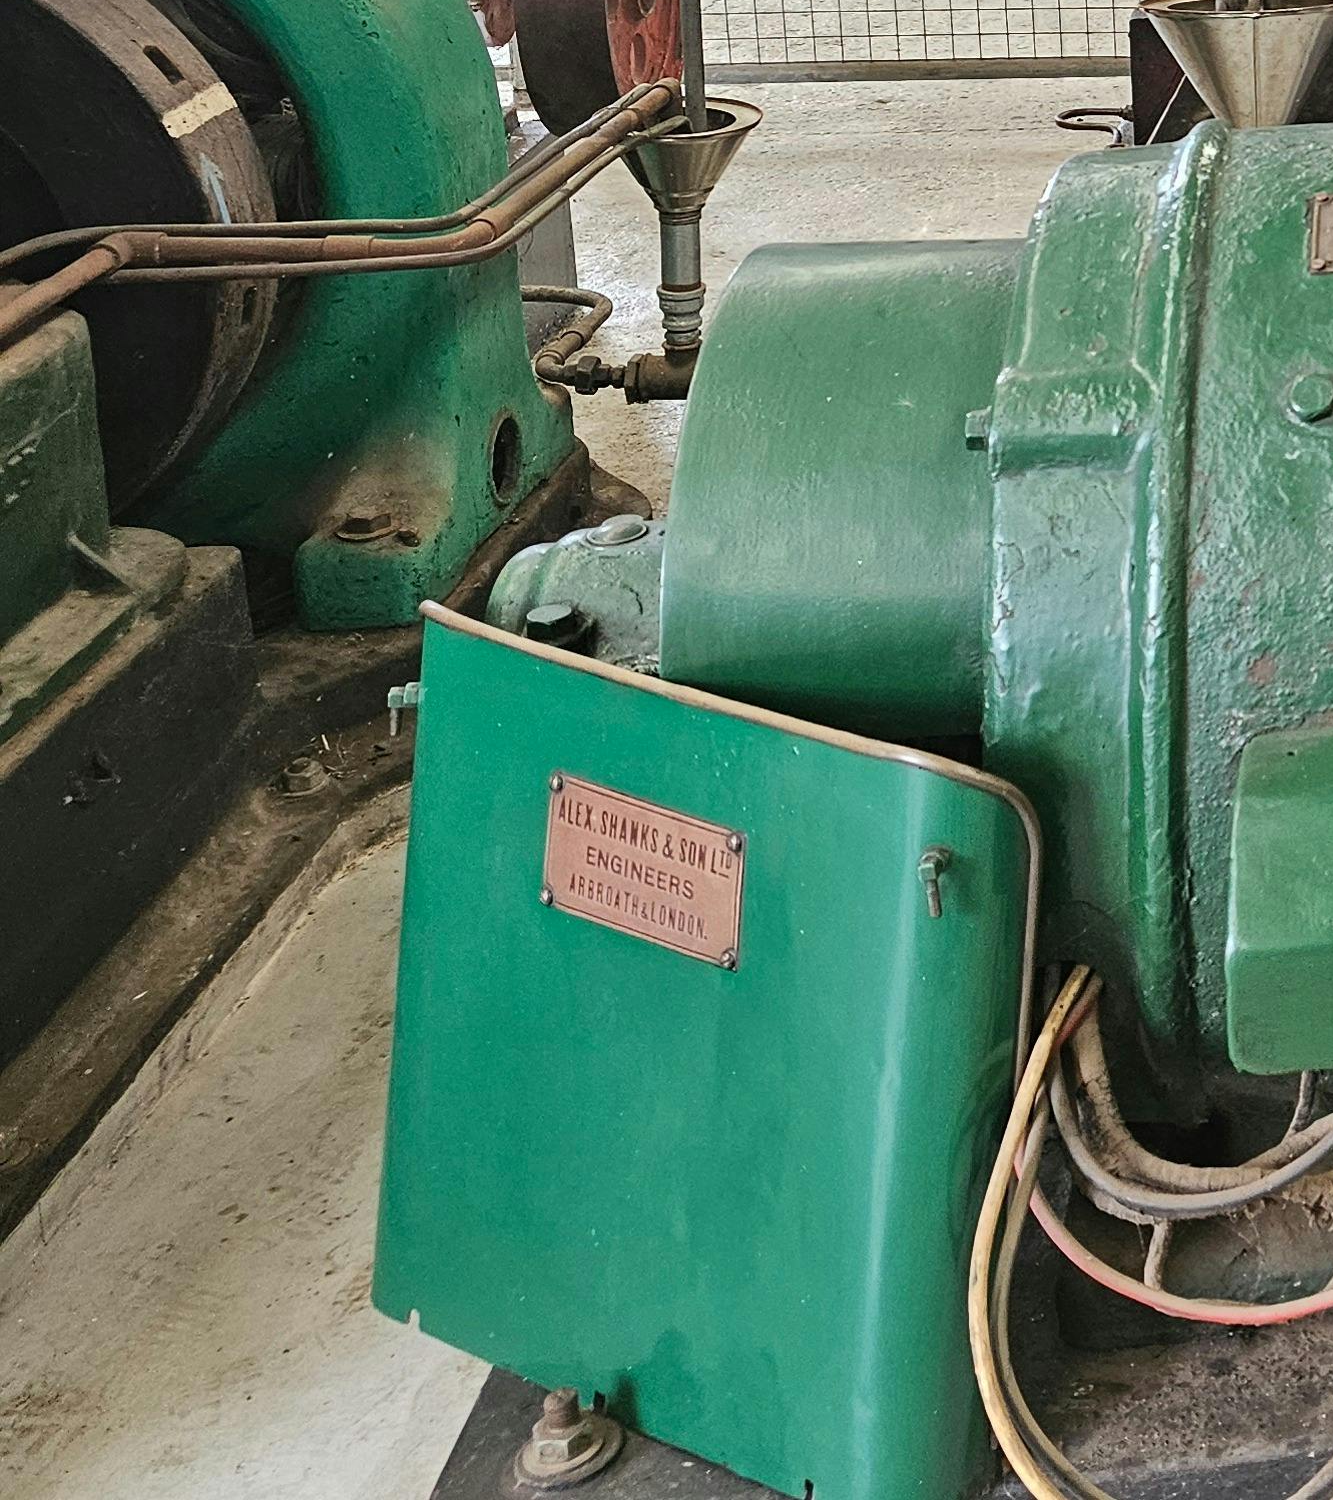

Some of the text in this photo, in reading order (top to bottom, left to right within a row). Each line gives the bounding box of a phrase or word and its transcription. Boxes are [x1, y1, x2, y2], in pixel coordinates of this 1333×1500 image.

[558, 795, 597, 834] ALEX.
[600, 810, 659, 854] SHANKS
[662, 833, 675, 862] &
[678, 837, 708, 871] SON
[585, 845, 695, 901] ENGINEERS
